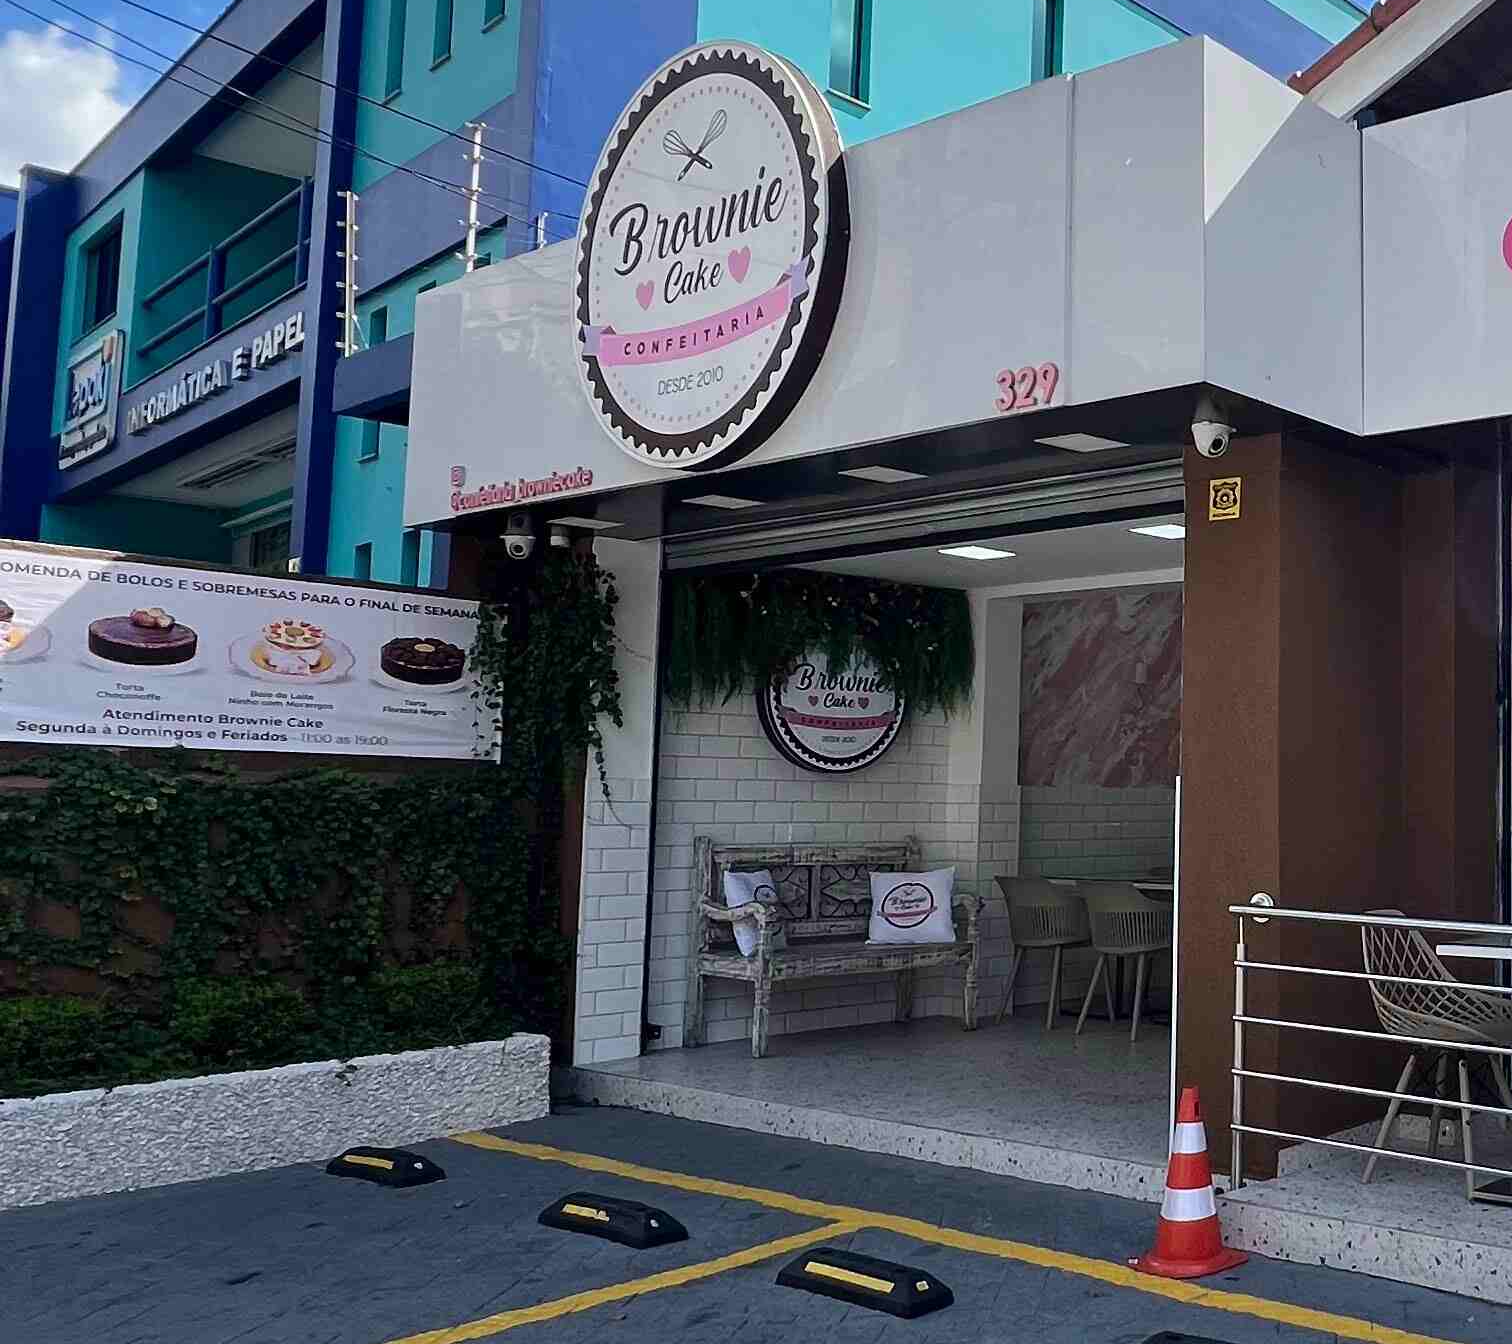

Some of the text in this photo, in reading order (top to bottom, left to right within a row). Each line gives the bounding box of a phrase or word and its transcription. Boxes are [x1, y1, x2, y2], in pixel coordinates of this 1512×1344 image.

[609, 165, 788, 276] Brownie
[663, 258, 724, 305] Cake
[232, 344, 250, 381] E
[251, 311, 305, 368] PAPEL
[624, 307, 766, 356] CONFEITARIA
[657, 364, 725, 397] DESDE 2010
[995, 360, 1060, 411] 329
[88, 570, 111, 583] DE
[117, 573, 174, 589] BOLOS
[178, 579, 188, 590] E
[192, 581, 297, 601] SOBREMESAS
[301, 592, 340, 606] PARA
[344, 597, 356, 607] O
[359, 598, 399, 612] FINAL
[403, 603, 421, 614] DE
[423, 605, 480, 620] SEMANA
[794, 663, 888, 694] Brownie
[823, 692, 856, 708] Cake
[16, 720, 97, 735] Segunda
[118, 725, 202, 740] Domingos
[207, 730, 216, 739] e
[222, 729, 288, 742] Feriados
[102, 708, 324, 729] Atendimento Brownie Cake
